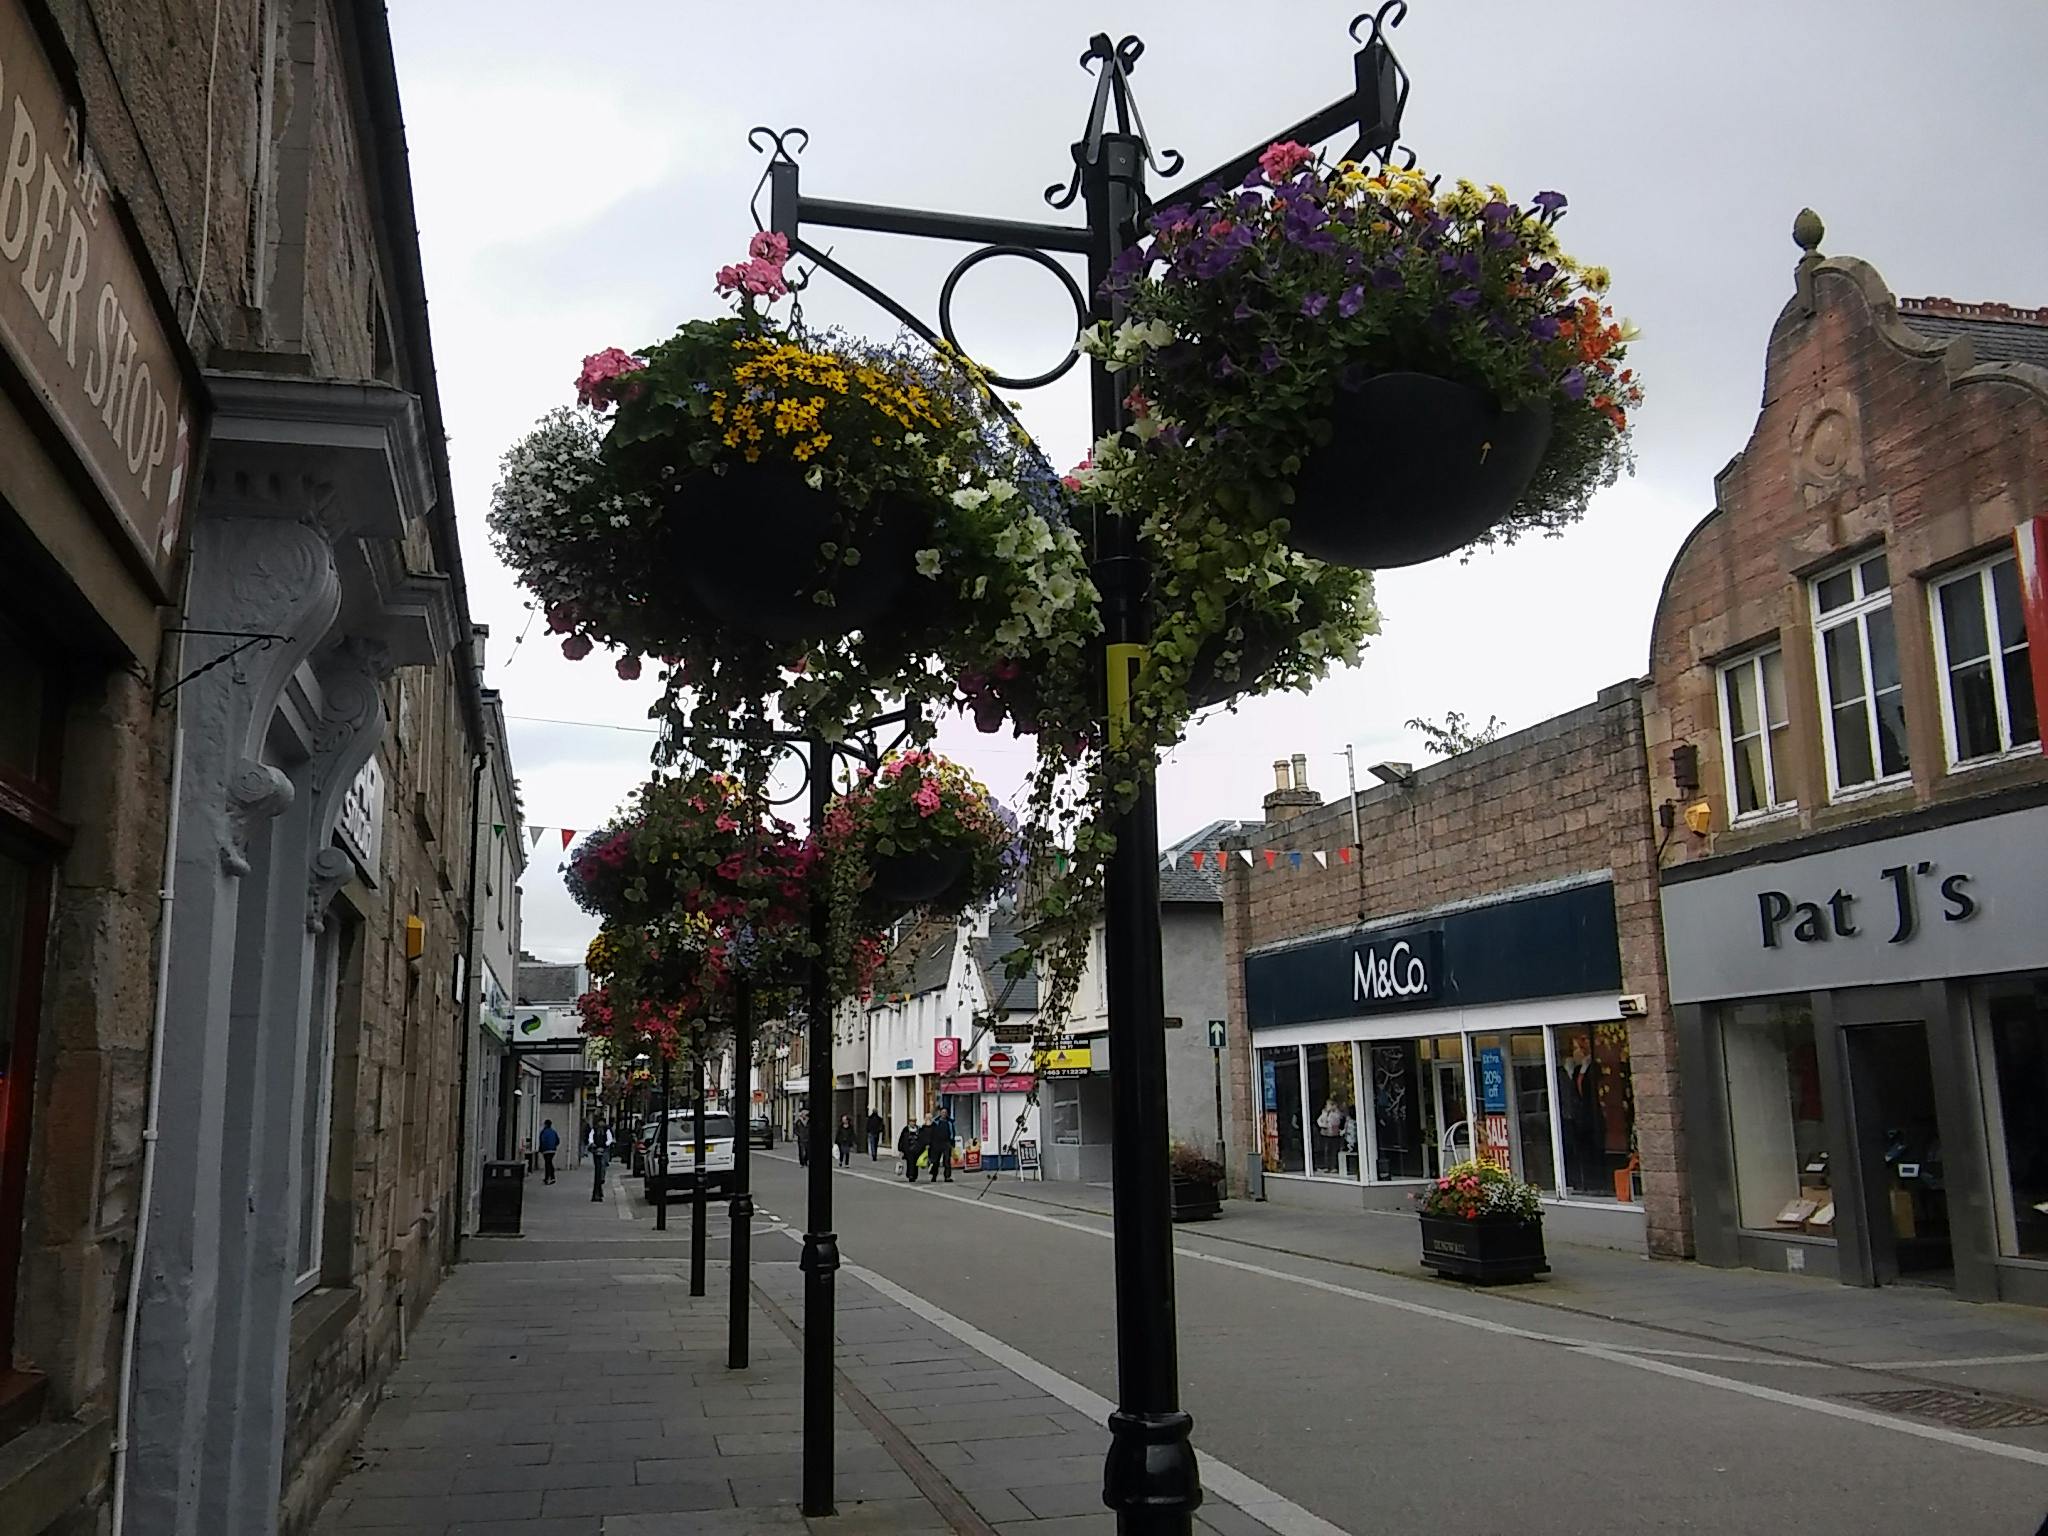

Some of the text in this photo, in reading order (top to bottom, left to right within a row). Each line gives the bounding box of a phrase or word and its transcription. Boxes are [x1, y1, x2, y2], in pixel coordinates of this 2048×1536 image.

[63, 107, 102, 228] THE
[0, 60, 167, 500] BER SHOP
[1758, 861, 1976, 948] Pat J's
[1354, 941, 1428, 1001] M&Co.
[1483, 1053, 1500, 1065] Extra
[1484, 1070, 1502, 1085] 20%
[1488, 1084, 1499, 1098] off
[1486, 1117, 1508, 1147] SALE
